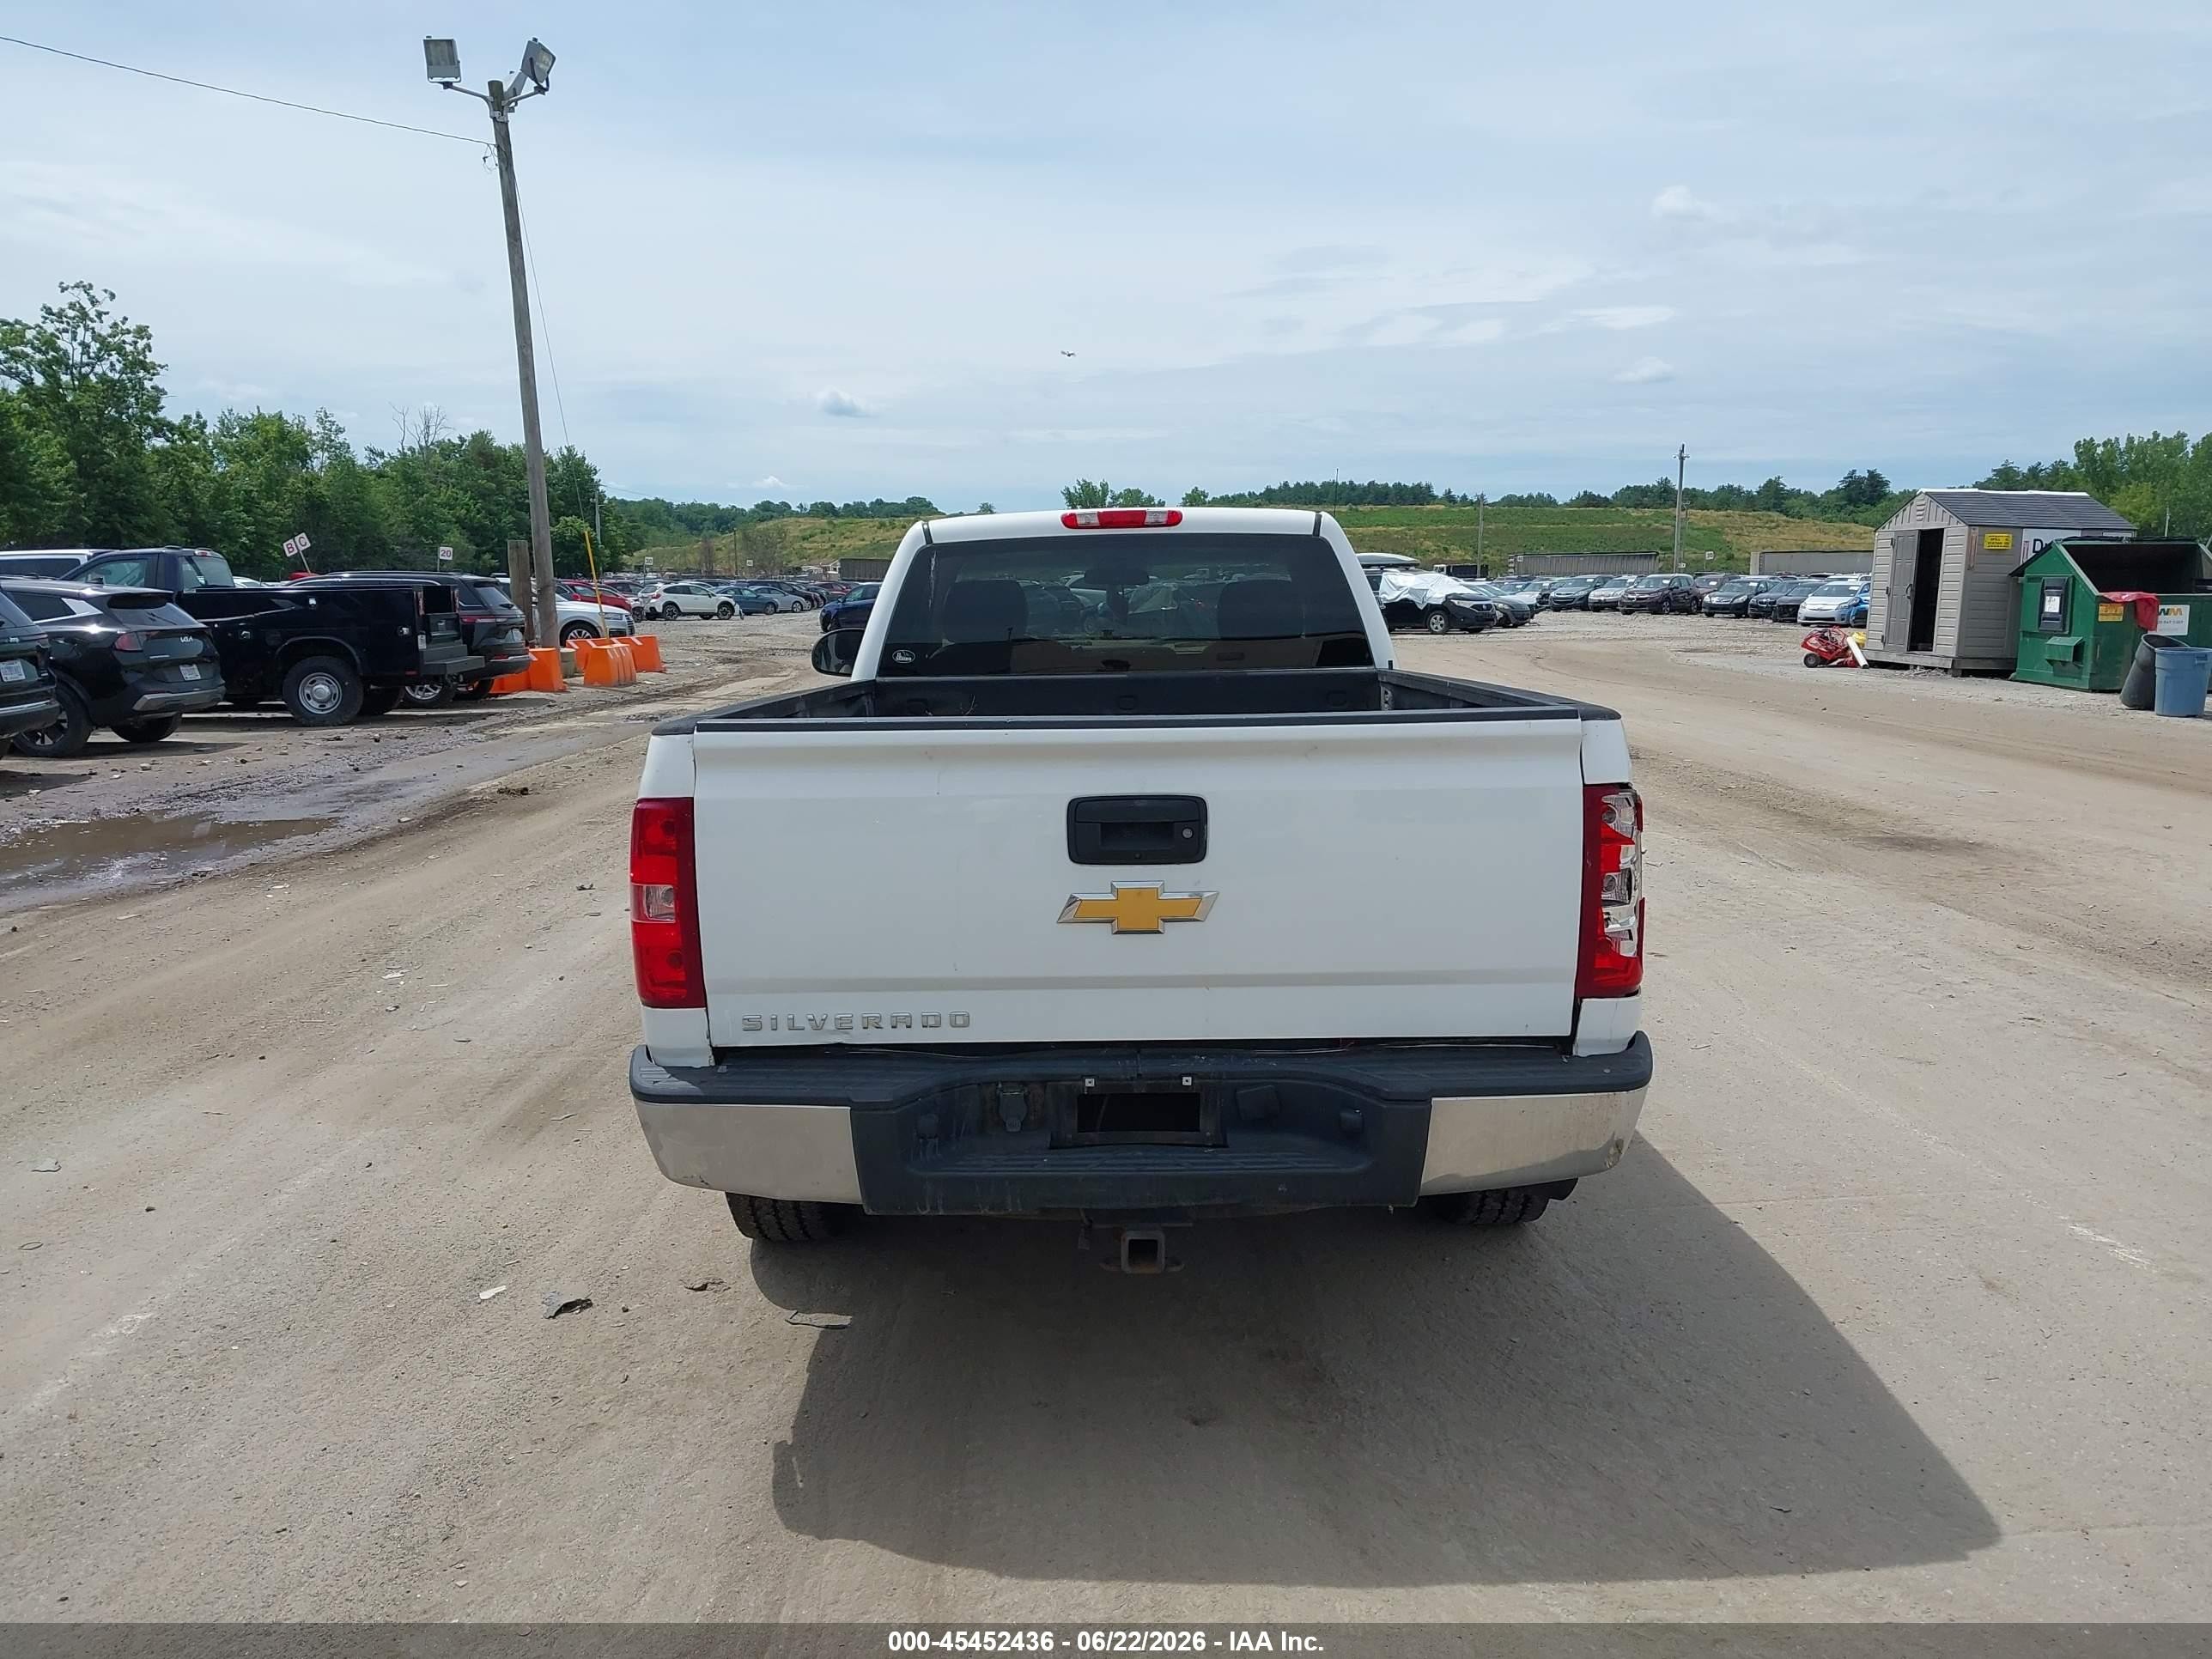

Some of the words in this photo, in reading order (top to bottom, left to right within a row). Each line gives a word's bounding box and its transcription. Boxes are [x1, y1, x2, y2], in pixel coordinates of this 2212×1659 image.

[298, 536, 307, 547] C
[286, 542, 295, 555] B
[441, 550, 452, 558] 20
[741, 1011, 971, 1031] SILVERADO
